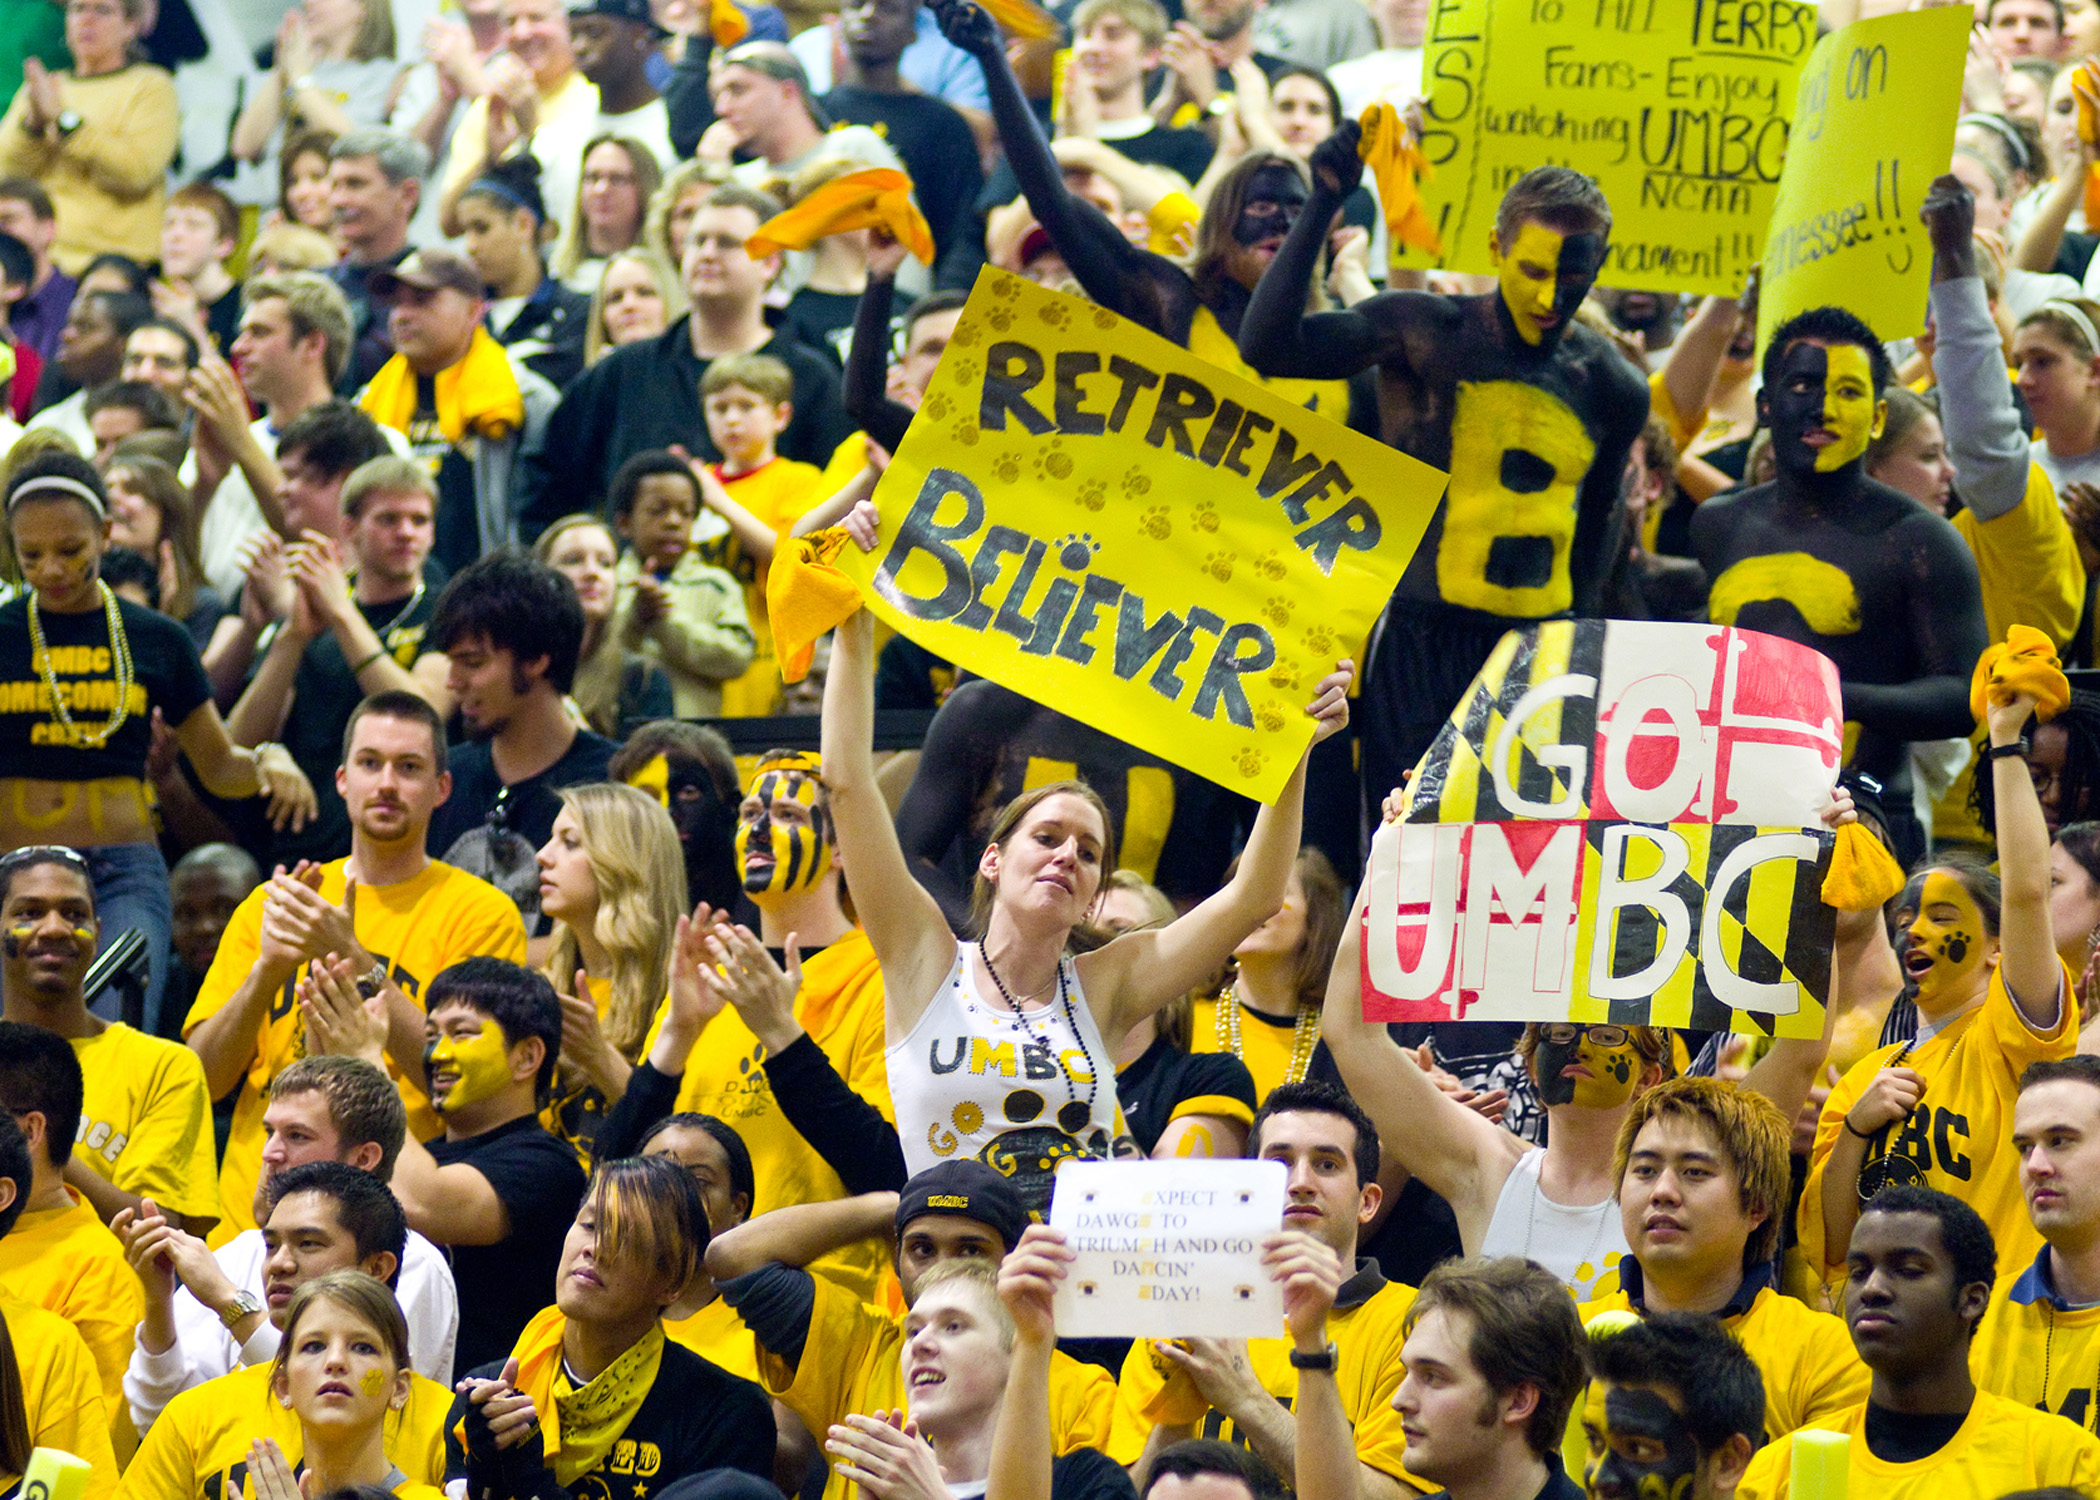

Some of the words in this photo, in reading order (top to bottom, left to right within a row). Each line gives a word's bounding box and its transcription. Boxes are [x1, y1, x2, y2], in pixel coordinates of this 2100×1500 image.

[1666, 56, 1779, 117] Enjoy
[979, 340, 1382, 577] RETRIEVER
[872, 466, 1276, 732] BELIEVER
[1491, 673, 1703, 823] GO
[1365, 823, 1820, 1016] UMBC
[929, 1036, 1098, 1084] UMBC
[1076, 1213, 1152, 1229] DAWGS
[1160, 1213, 1187, 1229] TO
[1141, 1190, 1218, 1206] EXPECT
[1074, 1237, 1166, 1253] TRIUMPH
[1175, 1238, 1217, 1254] AND
[1223, 1238, 1253, 1254] GO
[1113, 1260, 1195, 1277] DANCIN'
